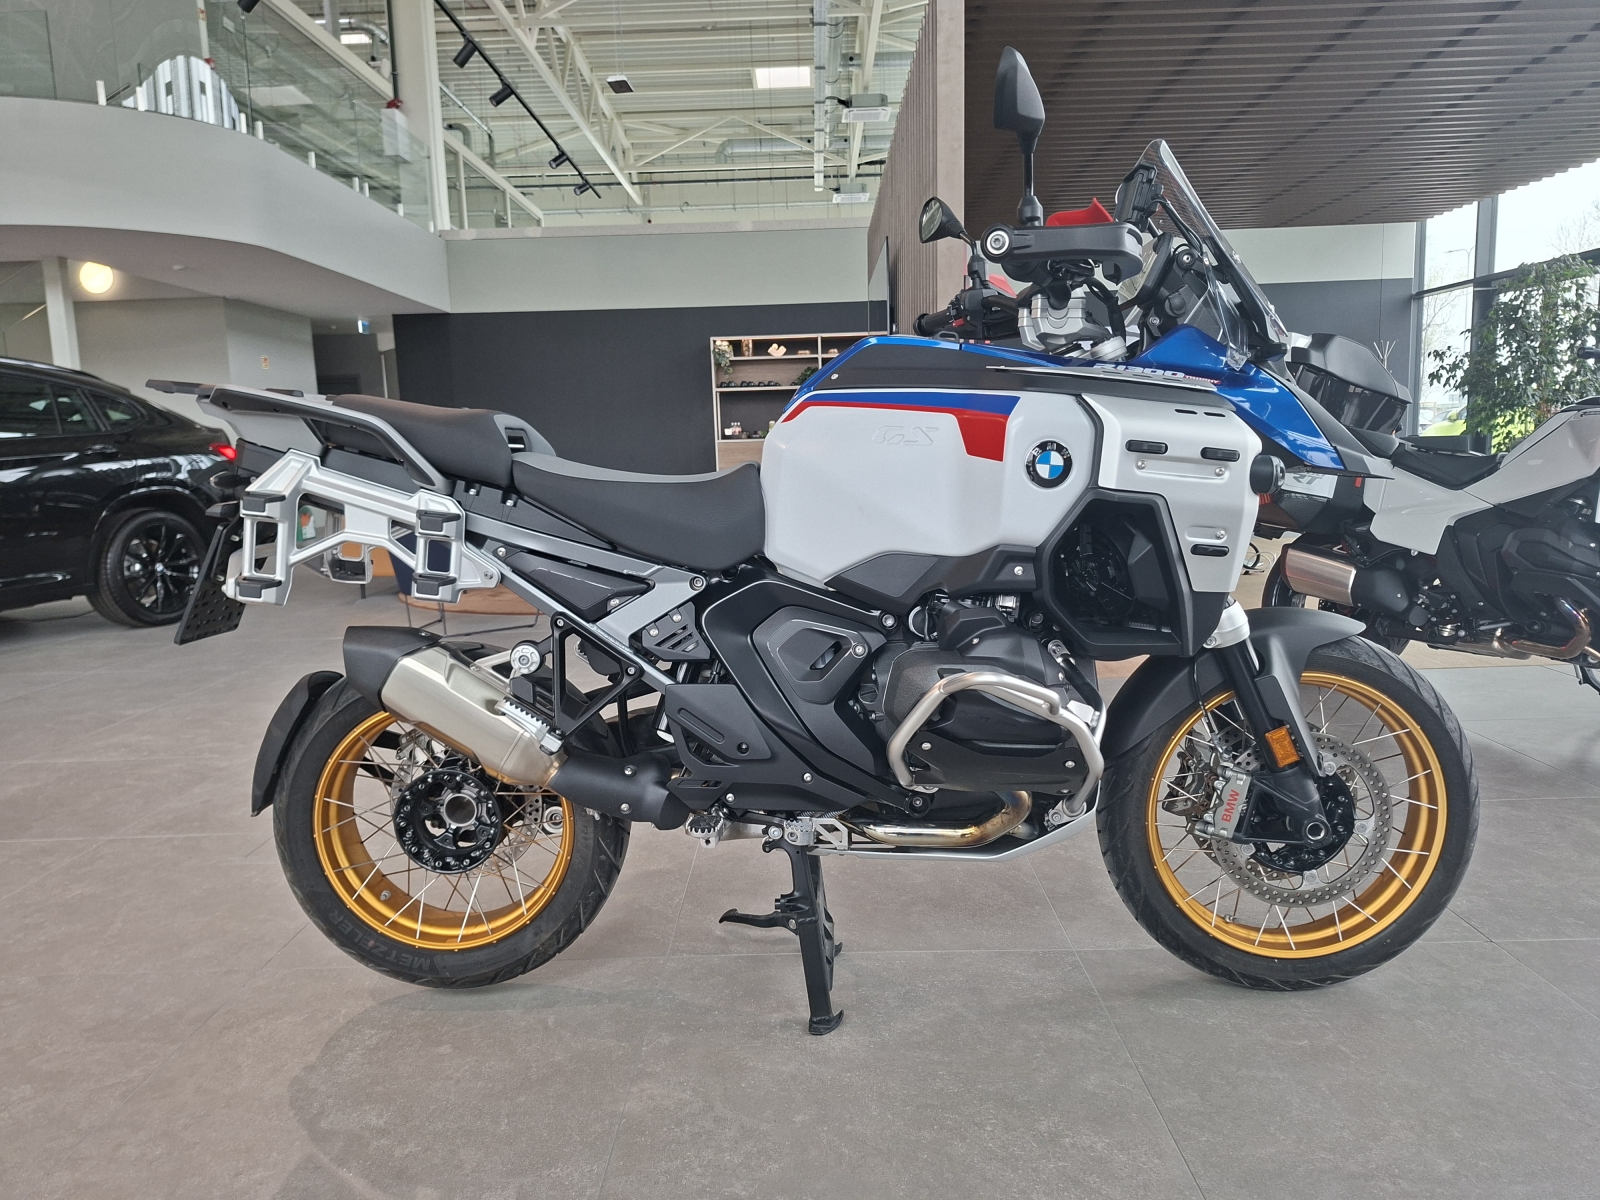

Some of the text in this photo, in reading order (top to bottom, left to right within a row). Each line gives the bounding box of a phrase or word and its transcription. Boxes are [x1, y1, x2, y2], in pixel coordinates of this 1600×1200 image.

[871, 424, 939, 446] GS
[1032, 442, 1070, 459] BMW
[1220, 789, 1241, 823] BMW
[328, 908, 431, 971] METZELER
